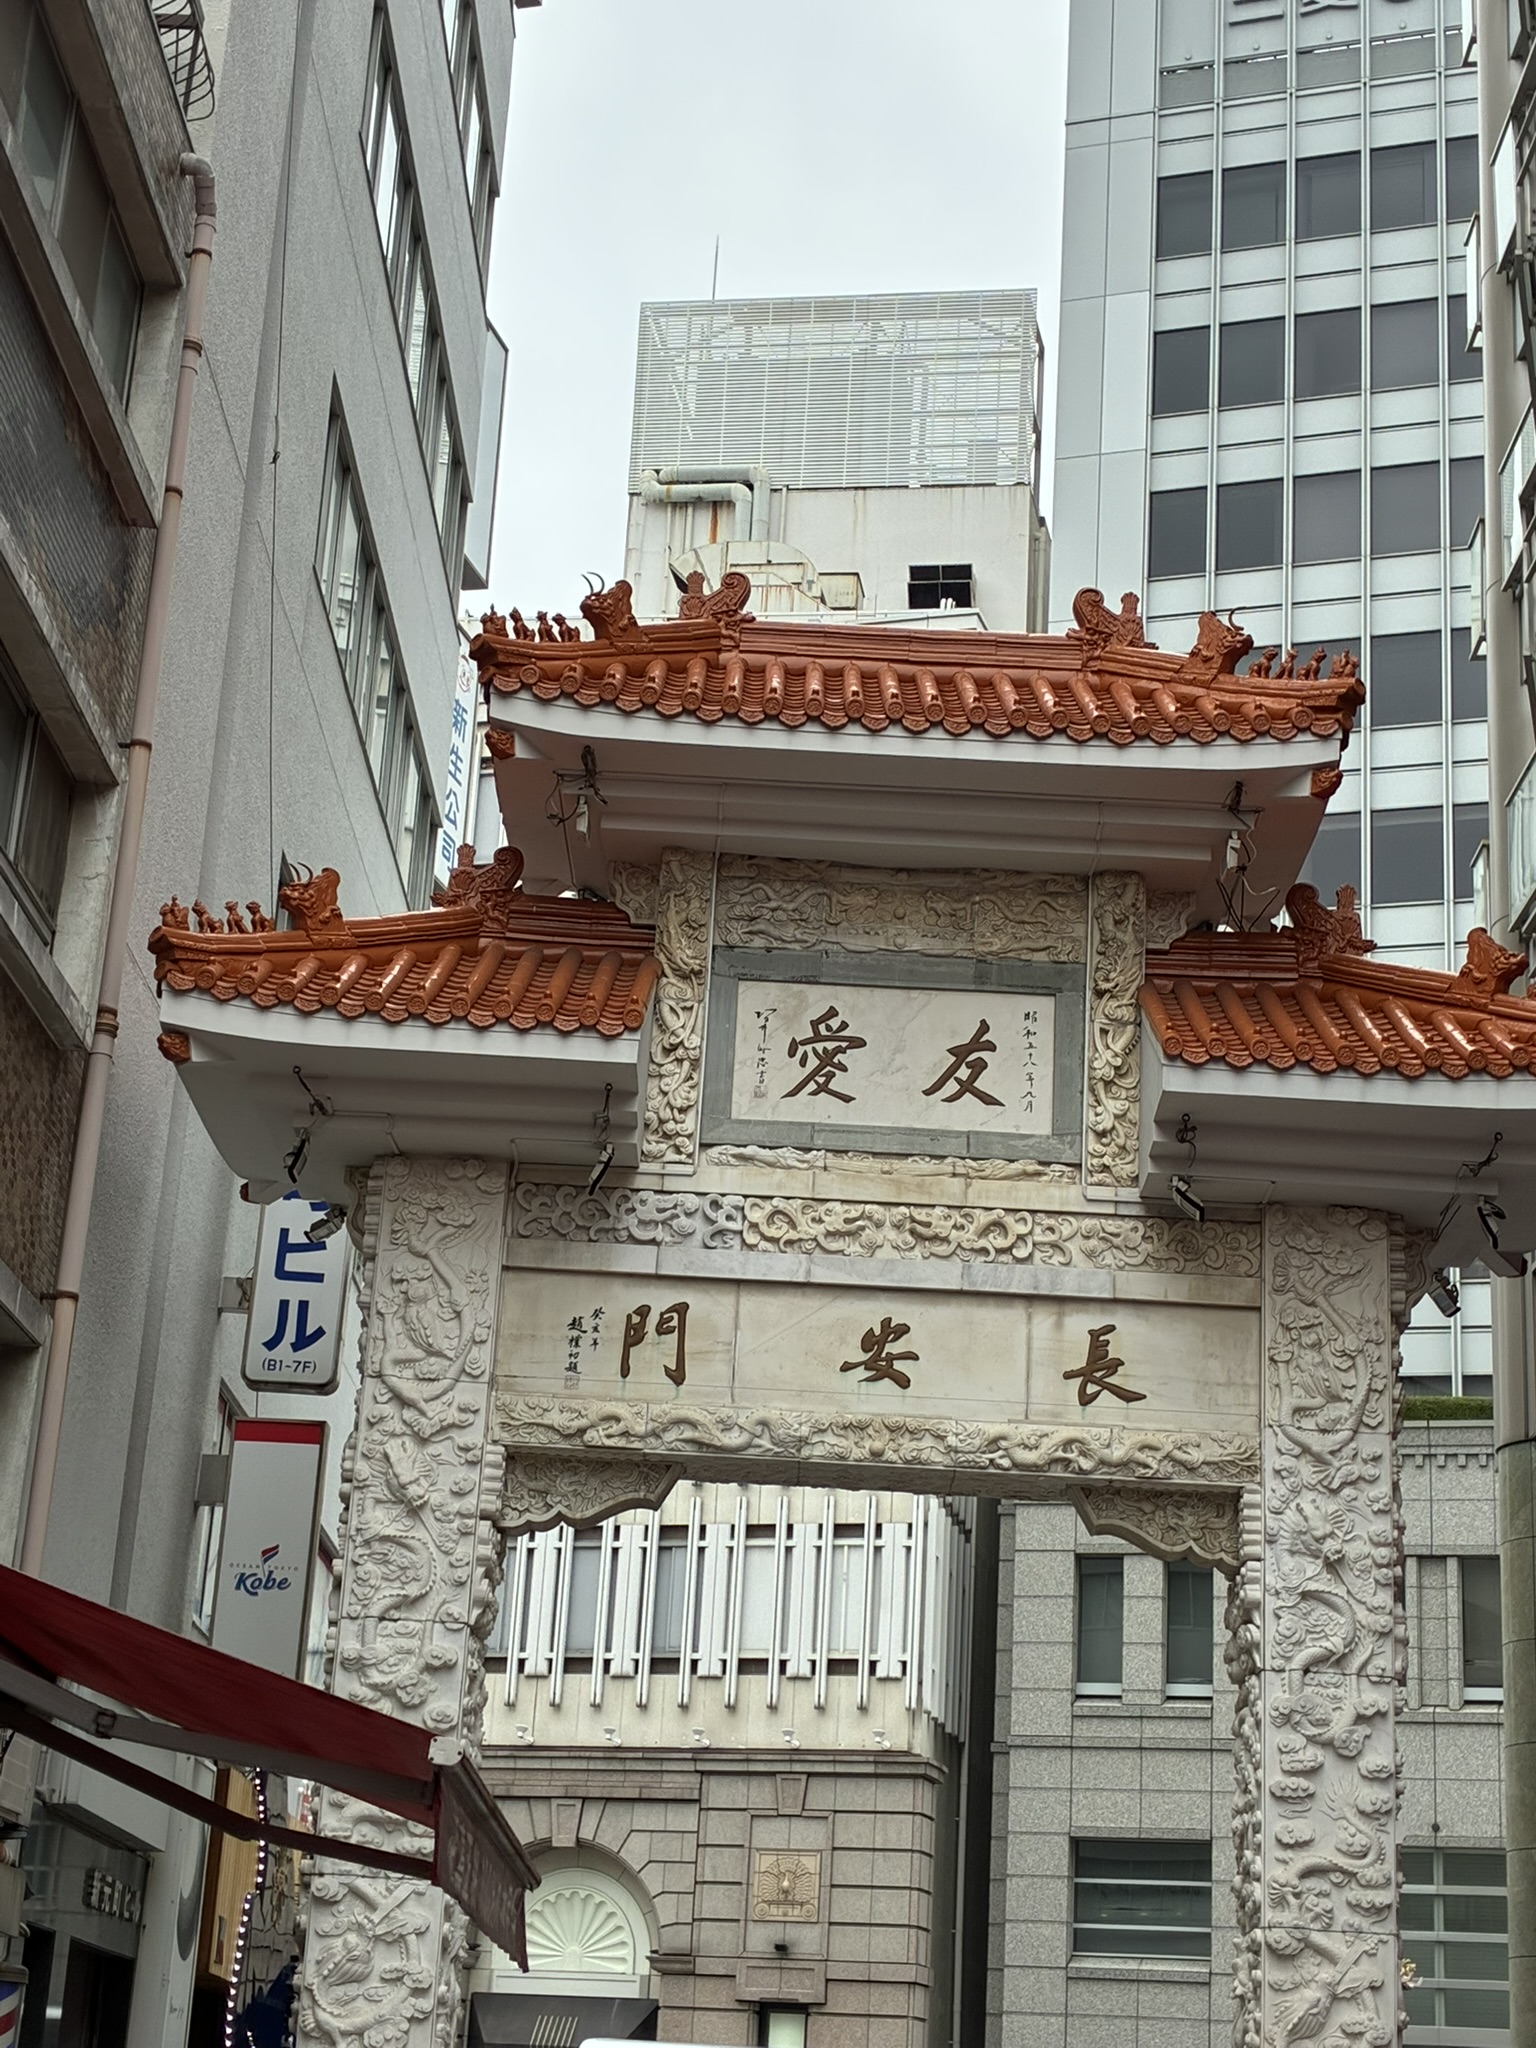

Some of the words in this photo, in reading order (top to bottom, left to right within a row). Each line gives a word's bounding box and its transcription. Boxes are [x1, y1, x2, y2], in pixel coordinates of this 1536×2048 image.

[442, 698, 468, 873] 新生公司
[234, 1570, 292, 1597] Kobe
